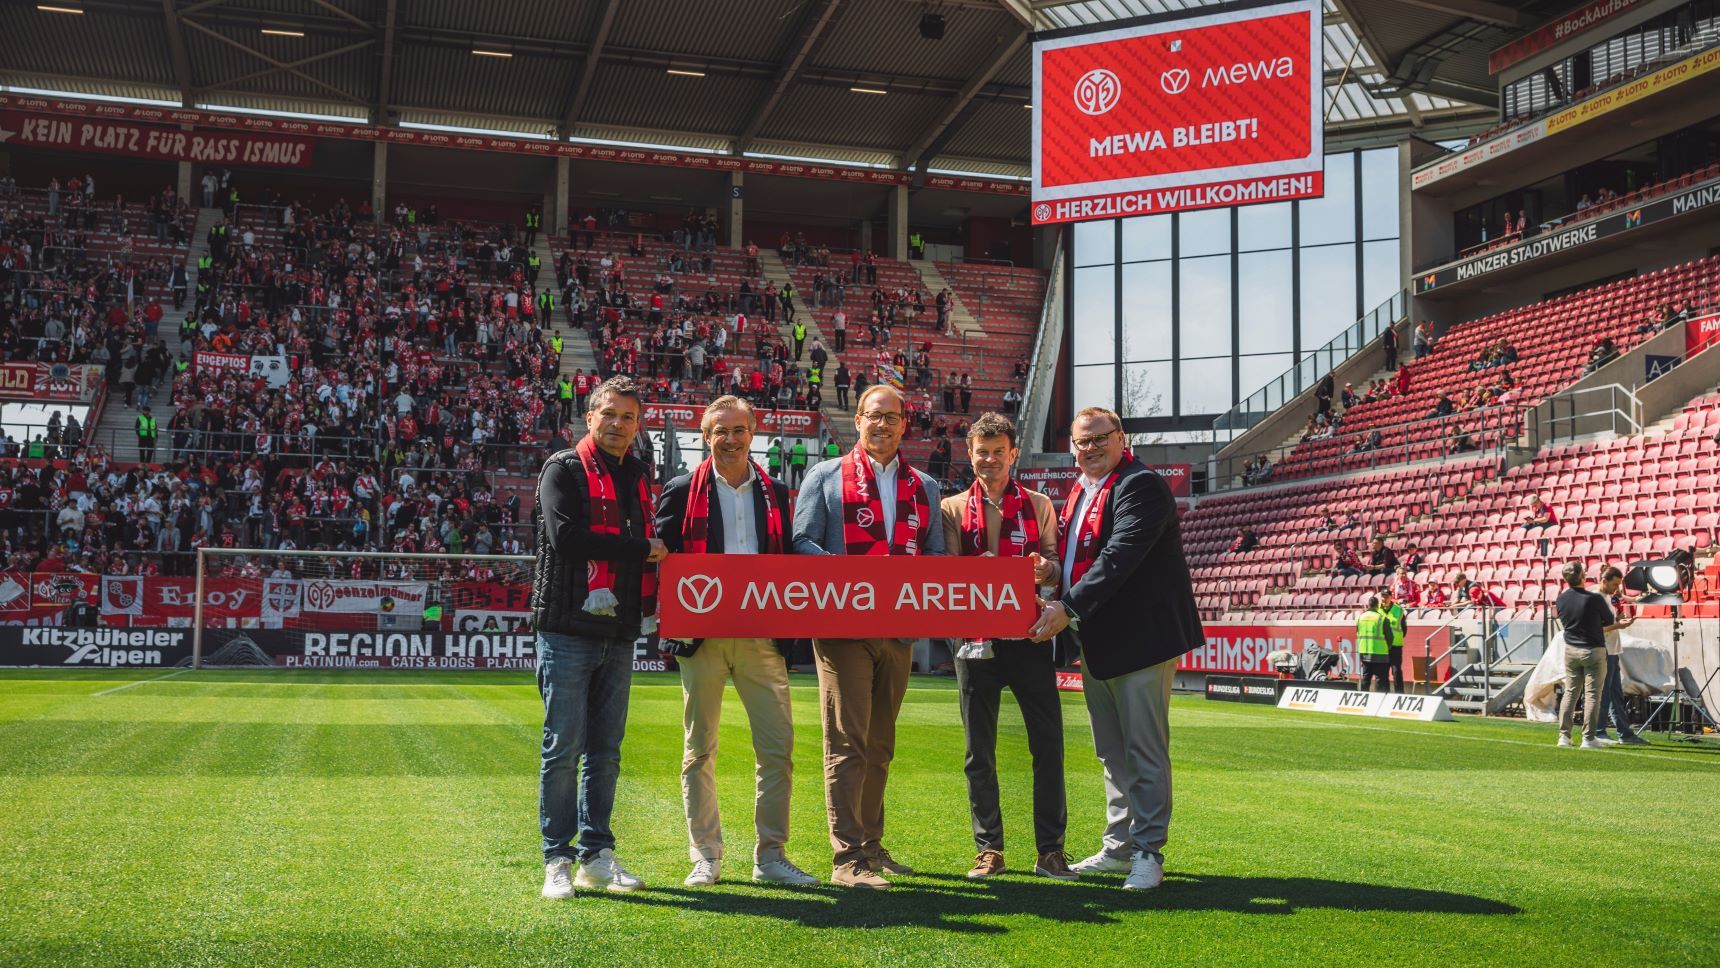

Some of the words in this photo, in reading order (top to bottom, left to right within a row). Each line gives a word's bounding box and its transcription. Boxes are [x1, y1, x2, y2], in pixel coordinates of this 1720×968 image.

[1555, 0, 1637, 39] #BockAufBa
[1201, 56, 1293, 88] mewa
[1663, 64, 1688, 81] LOTTO
[1625, 80, 1648, 96] LOTTO
[26, 99, 47, 107] LOTTO
[65, 103, 86, 111] LOTTO
[104, 106, 125, 114] LOTTO
[1589, 96, 1612, 111] LOTTO
[179, 113, 199, 121] LOTTO
[1556, 110, 1577, 125] LOTTO
[21, 118, 72, 144] KEIN
[80, 124, 140, 151] PLATZ
[146, 131, 186, 157] FÜR
[1090, 130, 1167, 157] MEWA
[1172, 118, 1258, 148] BLEIBT!
[733, 188, 740, 198] S
[1056, 194, 1152, 219] HERZLICH
[1156, 176, 1313, 209] WILLKOMMEN!
[1673, 187, 1720, 214] MAINZ
[1457, 253, 1508, 280] MAINZER
[1510, 224, 1597, 264] STADTWERKE
[1649, 360, 1662, 378] A
[658, 408, 694, 420] LOTTO
[776, 414, 811, 425] LOTTO
[1020, 472, 1078, 480] FAMILIENBLOCK
[1042, 487, 1059, 496] SVA
[740, 581, 875, 611] mewa
[895, 582, 1021, 611] ARENA
[22, 628, 184, 649] Kitzbüheler
[304, 632, 433, 657] REGION
[64, 644, 162, 667] Alpen
[286, 656, 379, 667] PLATINUM.com
[391, 656, 424, 668] CATS
[427, 657, 437, 668] &
[440, 657, 475, 668] DOGS
[632, 660, 666, 671] DOGS
[1213, 684, 1240, 694] BUNDESLIGA
[1248, 686, 1275, 696] BUNDESLIGA
[1290, 688, 1319, 704] NTA
[1339, 691, 1370, 707] NTA
[1392, 695, 1425, 712] NTA
